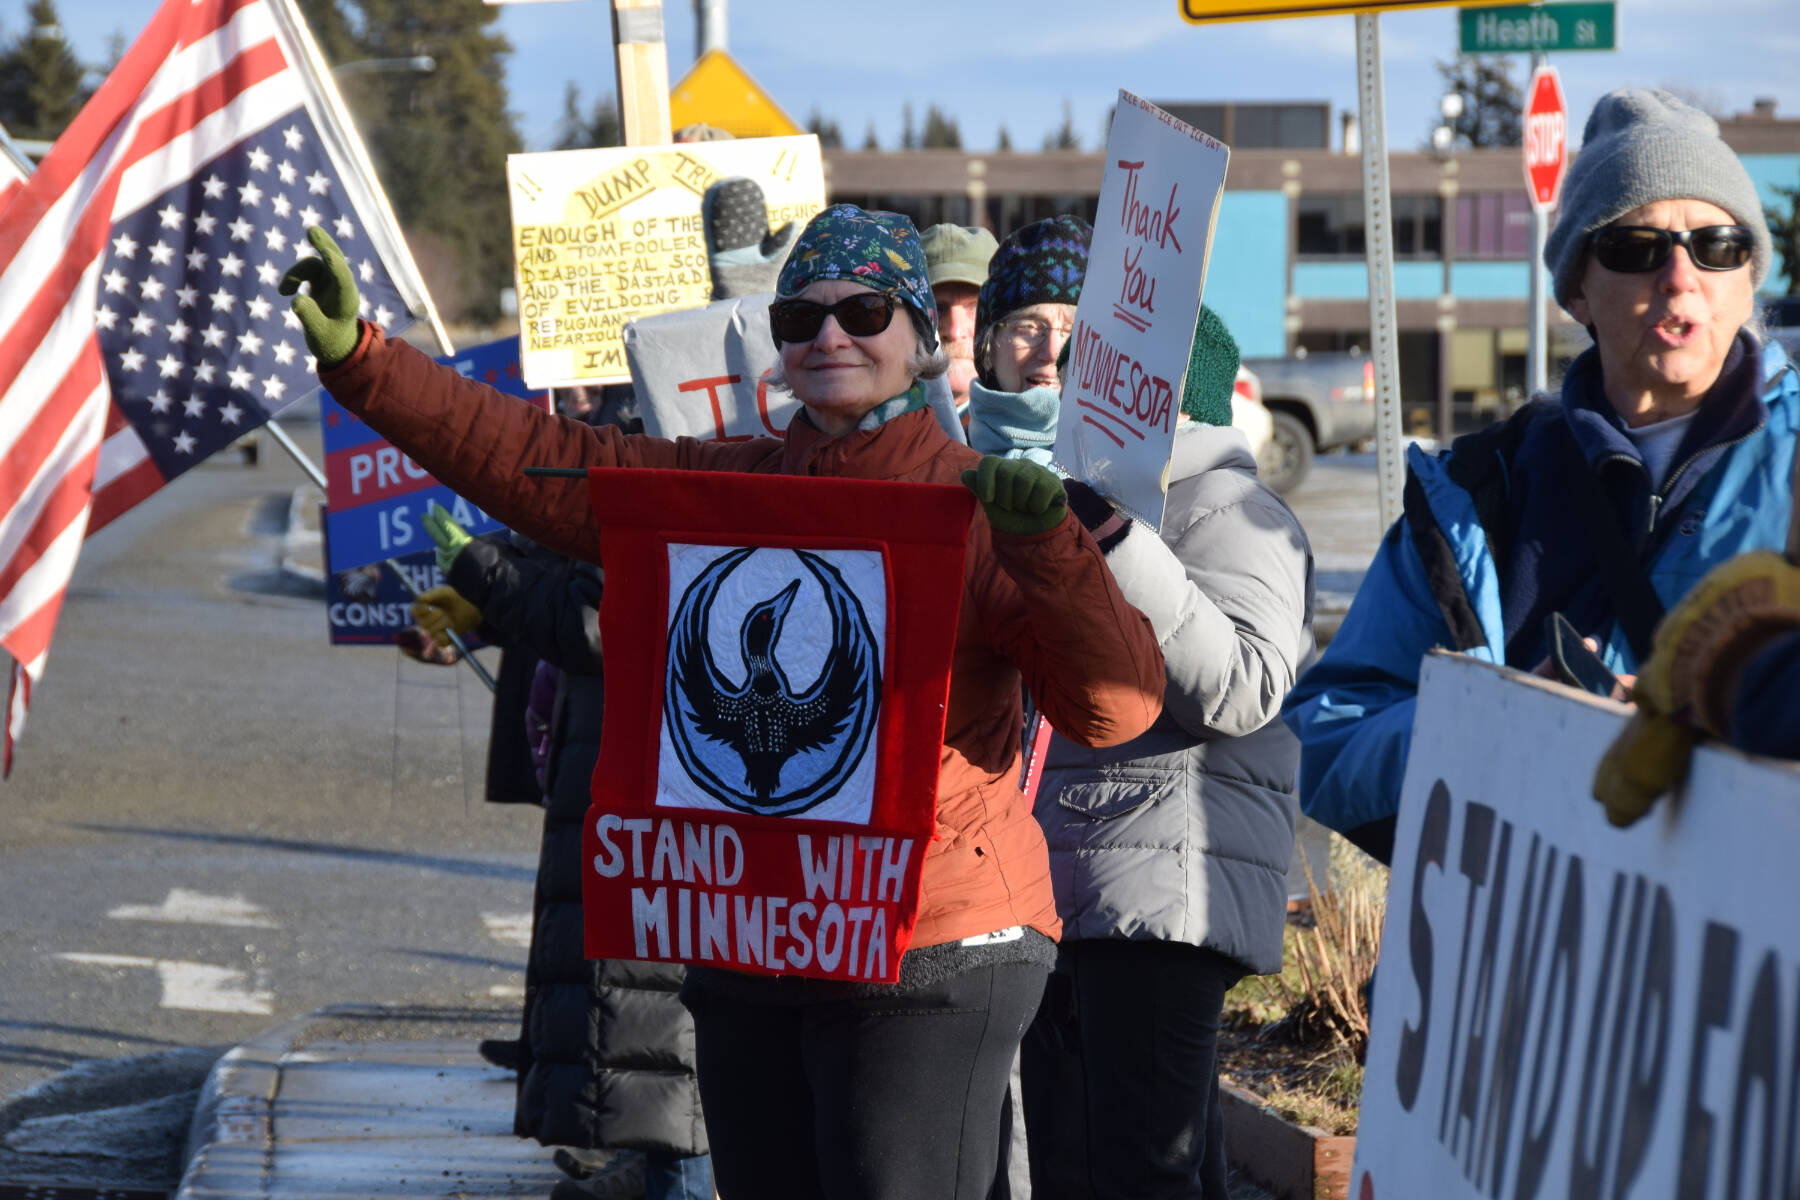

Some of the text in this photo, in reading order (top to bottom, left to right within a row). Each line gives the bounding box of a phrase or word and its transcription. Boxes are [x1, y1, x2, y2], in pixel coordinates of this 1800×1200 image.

[1476, 12, 1597, 47] Heath St
[1122, 90, 1221, 152] ICE OUT ICE OUT ICE OUT
[1528, 111, 1564, 166] STOP
[574, 158, 650, 219] DUMP
[1118, 160, 1182, 254] Thank
[519, 221, 616, 249] ENOUGH
[632, 217, 657, 238] OF
[664, 214, 703, 233] THE
[520, 235, 702, 267] AND TOMFOOLER
[520, 253, 706, 286] DIABOLICAL SCO
[522, 282, 559, 301] AND
[565, 278, 606, 295] THE
[1118, 247, 1155, 314] You
[524, 302, 550, 319] OF
[565, 289, 681, 315] EVILDOING
[583, 348, 623, 369] IM
[1072, 320, 1175, 434] MINNESOTA
[350, 447, 429, 495] PRO
[379, 505, 414, 550] IS
[330, 602, 411, 627] CONST
[594, 814, 914, 903] STAND WITH
[631, 886, 888, 980] MINNESOTA
